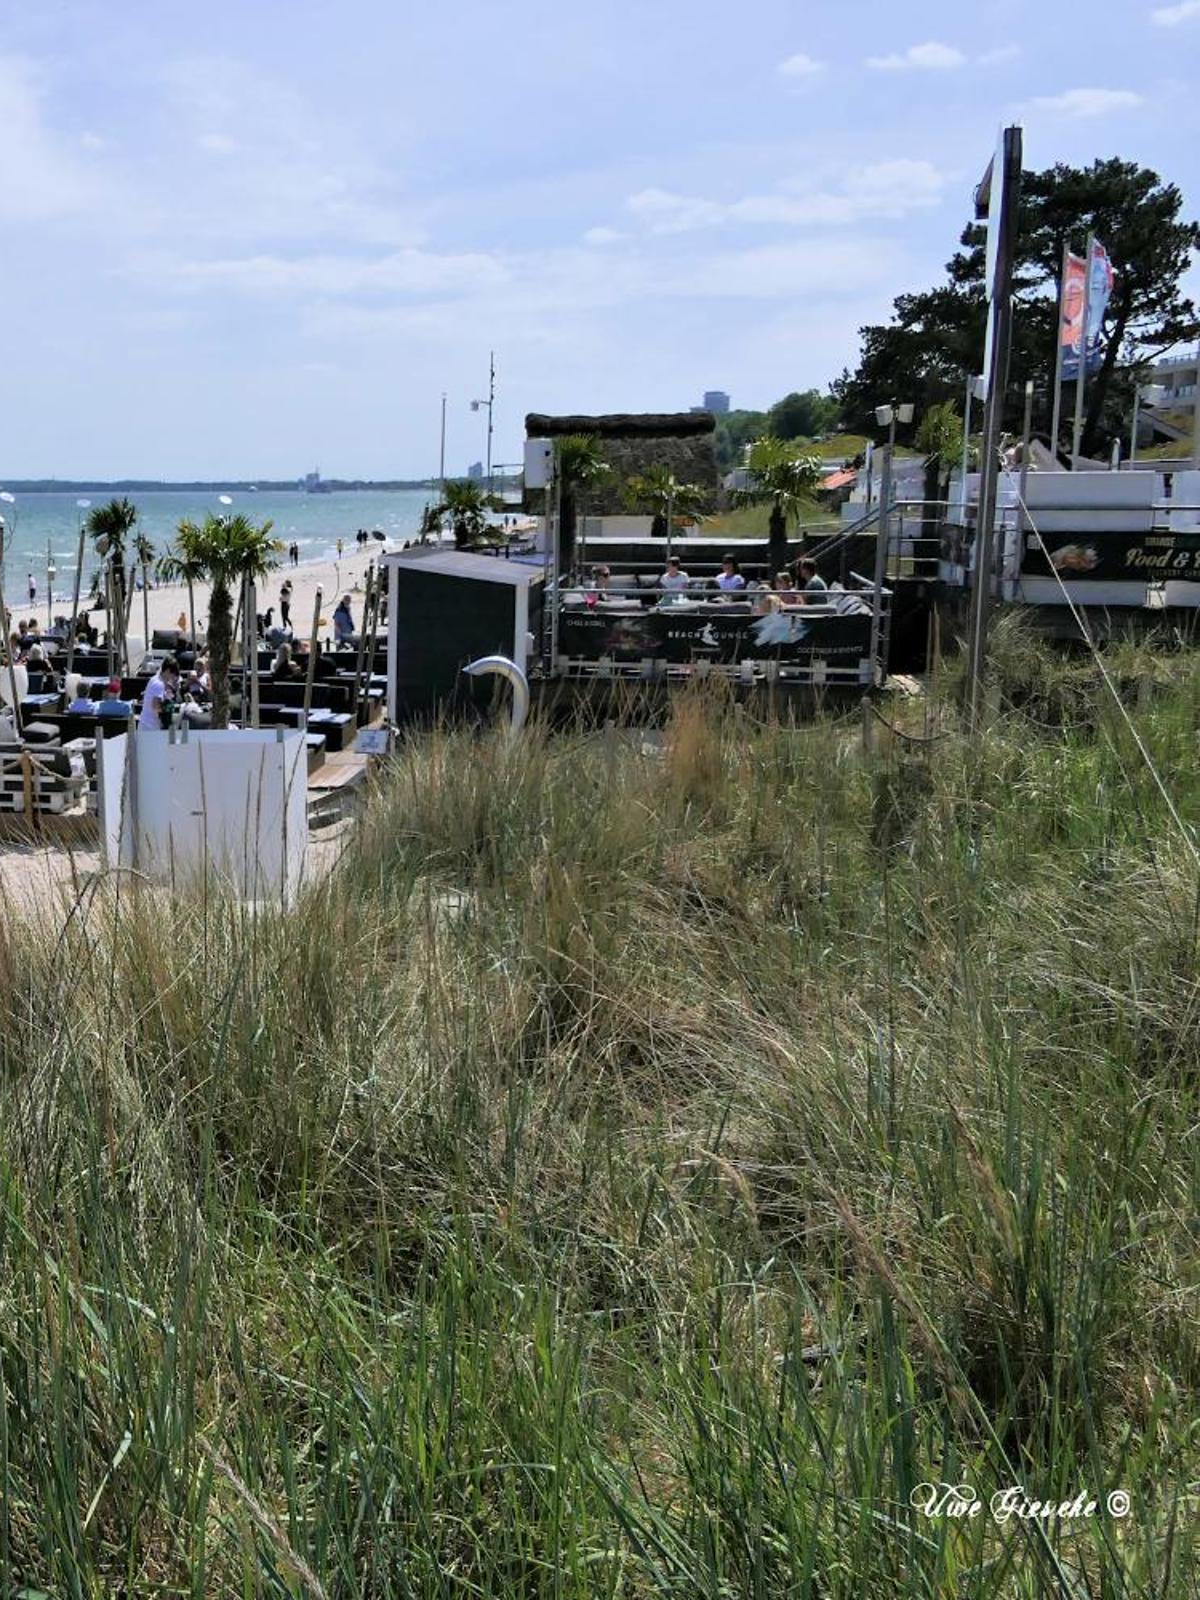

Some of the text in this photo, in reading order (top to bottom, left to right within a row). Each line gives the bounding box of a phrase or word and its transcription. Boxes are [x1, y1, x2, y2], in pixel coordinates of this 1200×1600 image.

[1125, 548, 1173, 567] Food
[1173, 551, 1191, 568] &
[668, 631, 701, 639] BEACH
